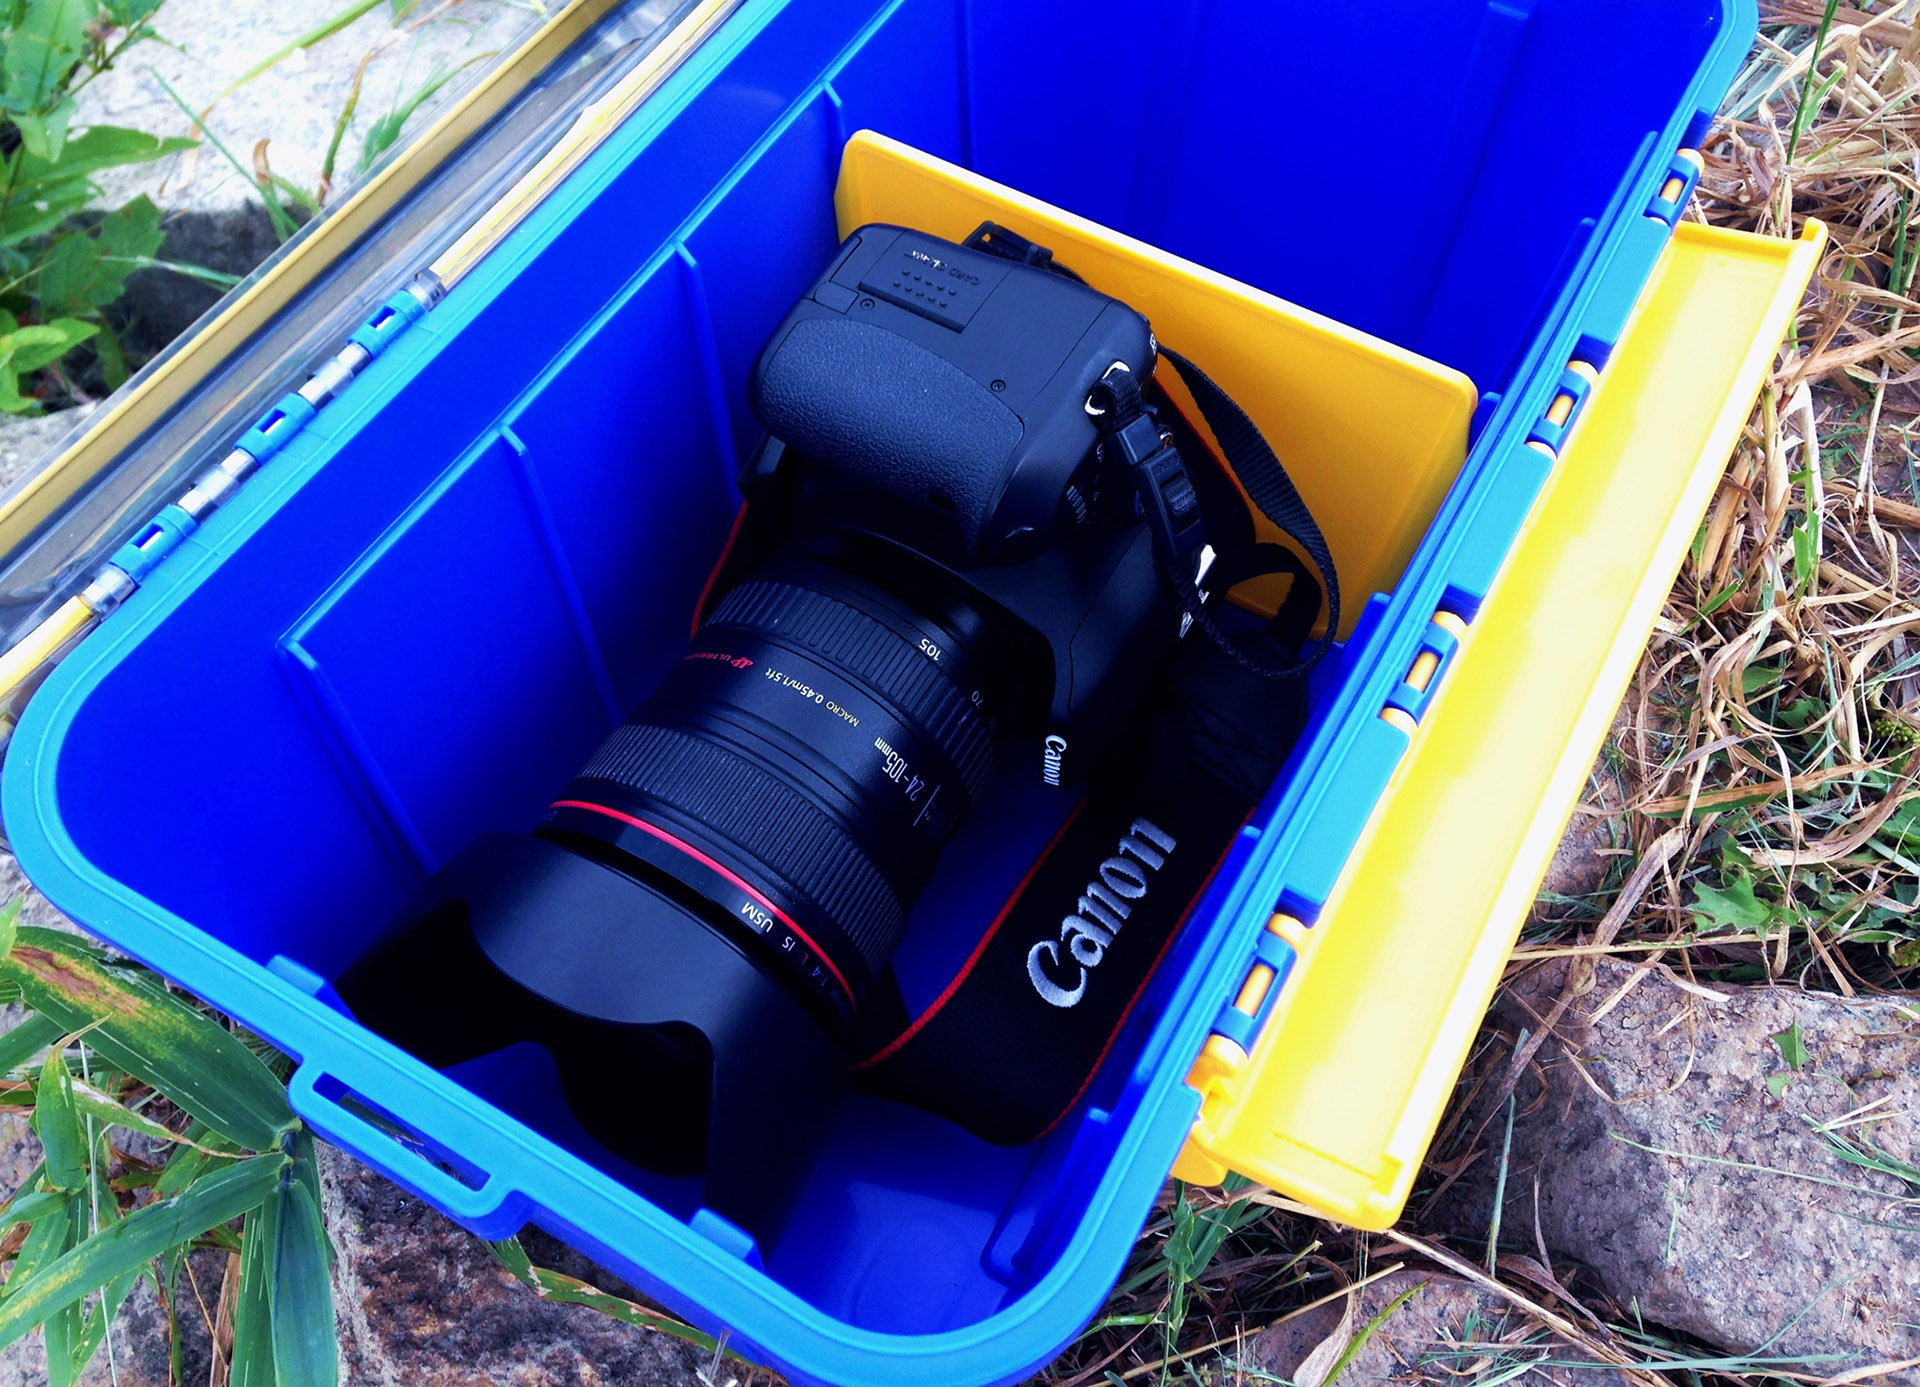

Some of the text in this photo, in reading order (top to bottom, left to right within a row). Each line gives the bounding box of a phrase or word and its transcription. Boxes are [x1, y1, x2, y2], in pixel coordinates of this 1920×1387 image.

[918, 637, 941, 662] 105
[765, 667, 861, 728] MACRO 0.45m/1.5ft
[971, 690, 985, 709] 70
[874, 736, 926, 802] 24-105mm
[1043, 734, 1068, 786] Canon
[741, 901, 774, 933] USM
[1026, 815, 1177, 1008] Canon
[781, 935, 797, 952] IS
[801, 951, 809, 966] L
